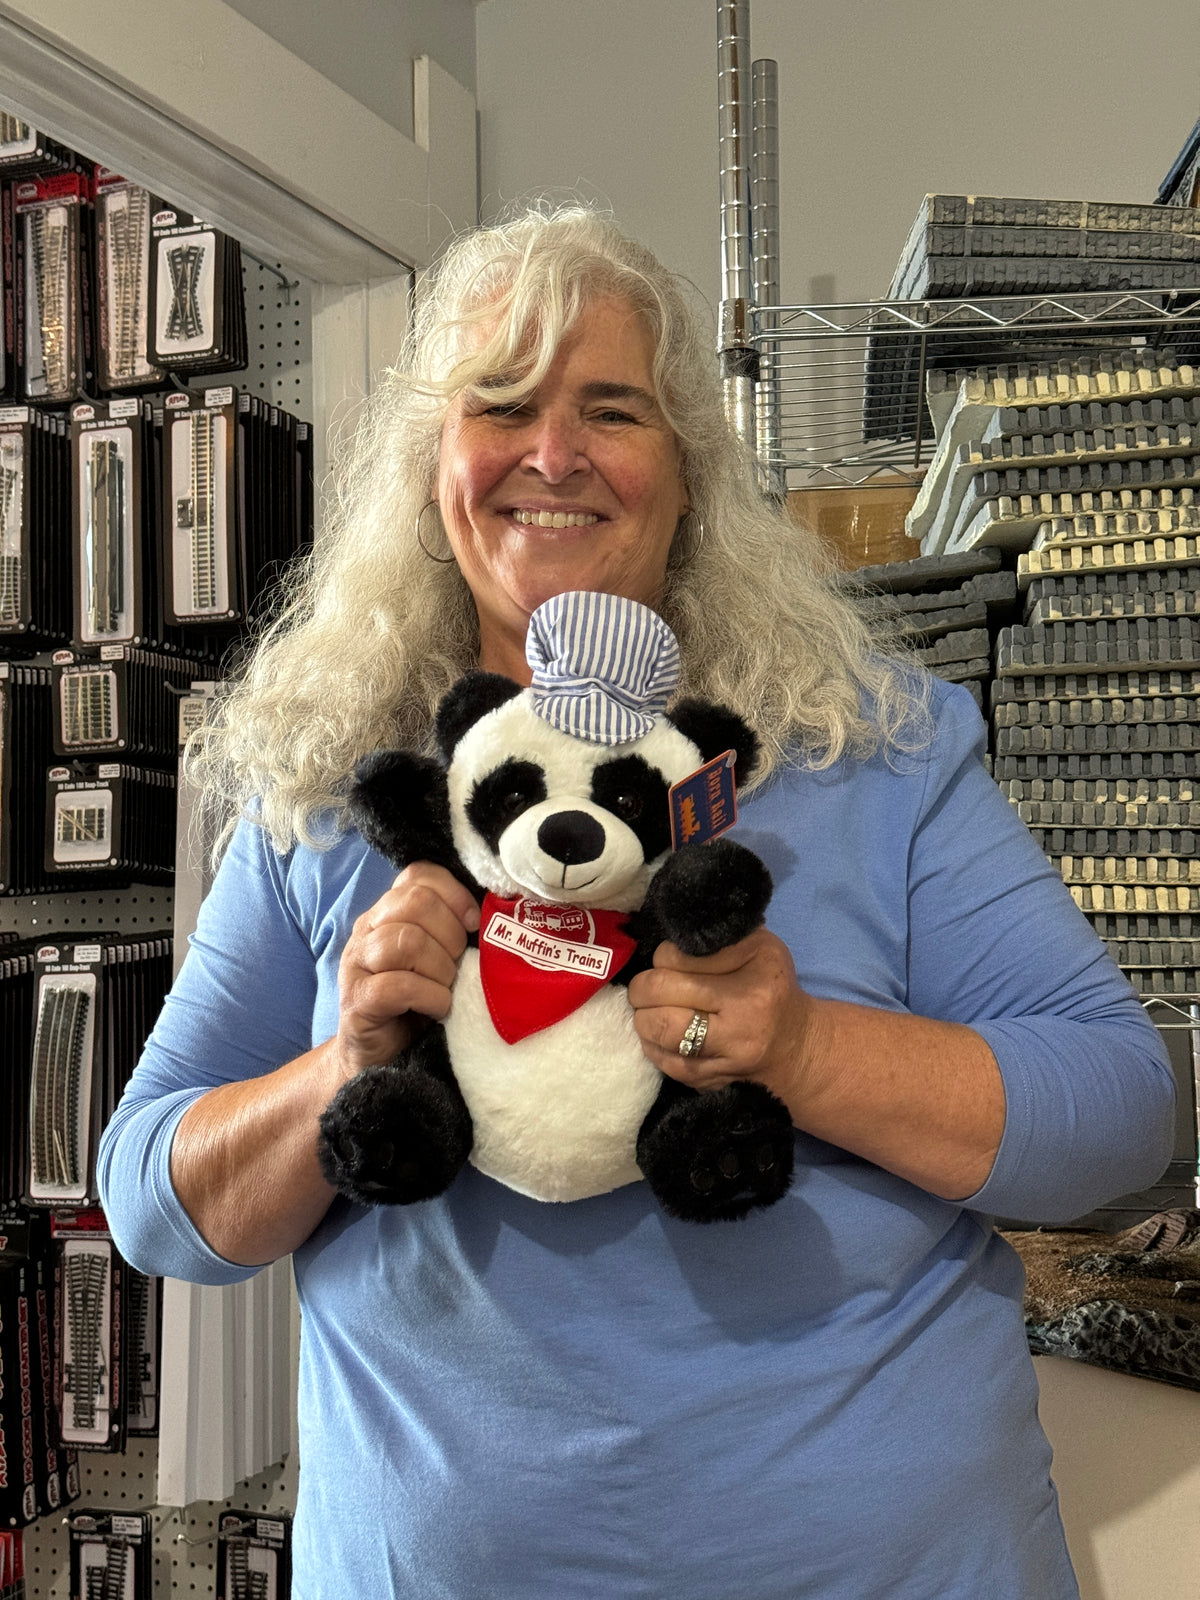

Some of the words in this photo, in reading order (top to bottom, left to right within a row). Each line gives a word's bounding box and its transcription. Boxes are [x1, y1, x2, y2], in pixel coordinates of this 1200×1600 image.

[707, 766, 723, 801] Born
[711, 798, 727, 831] Rail
[494, 923, 513, 942] Mr.
[516, 932, 562, 960] Muffin's
[566, 947, 603, 970] Trains
